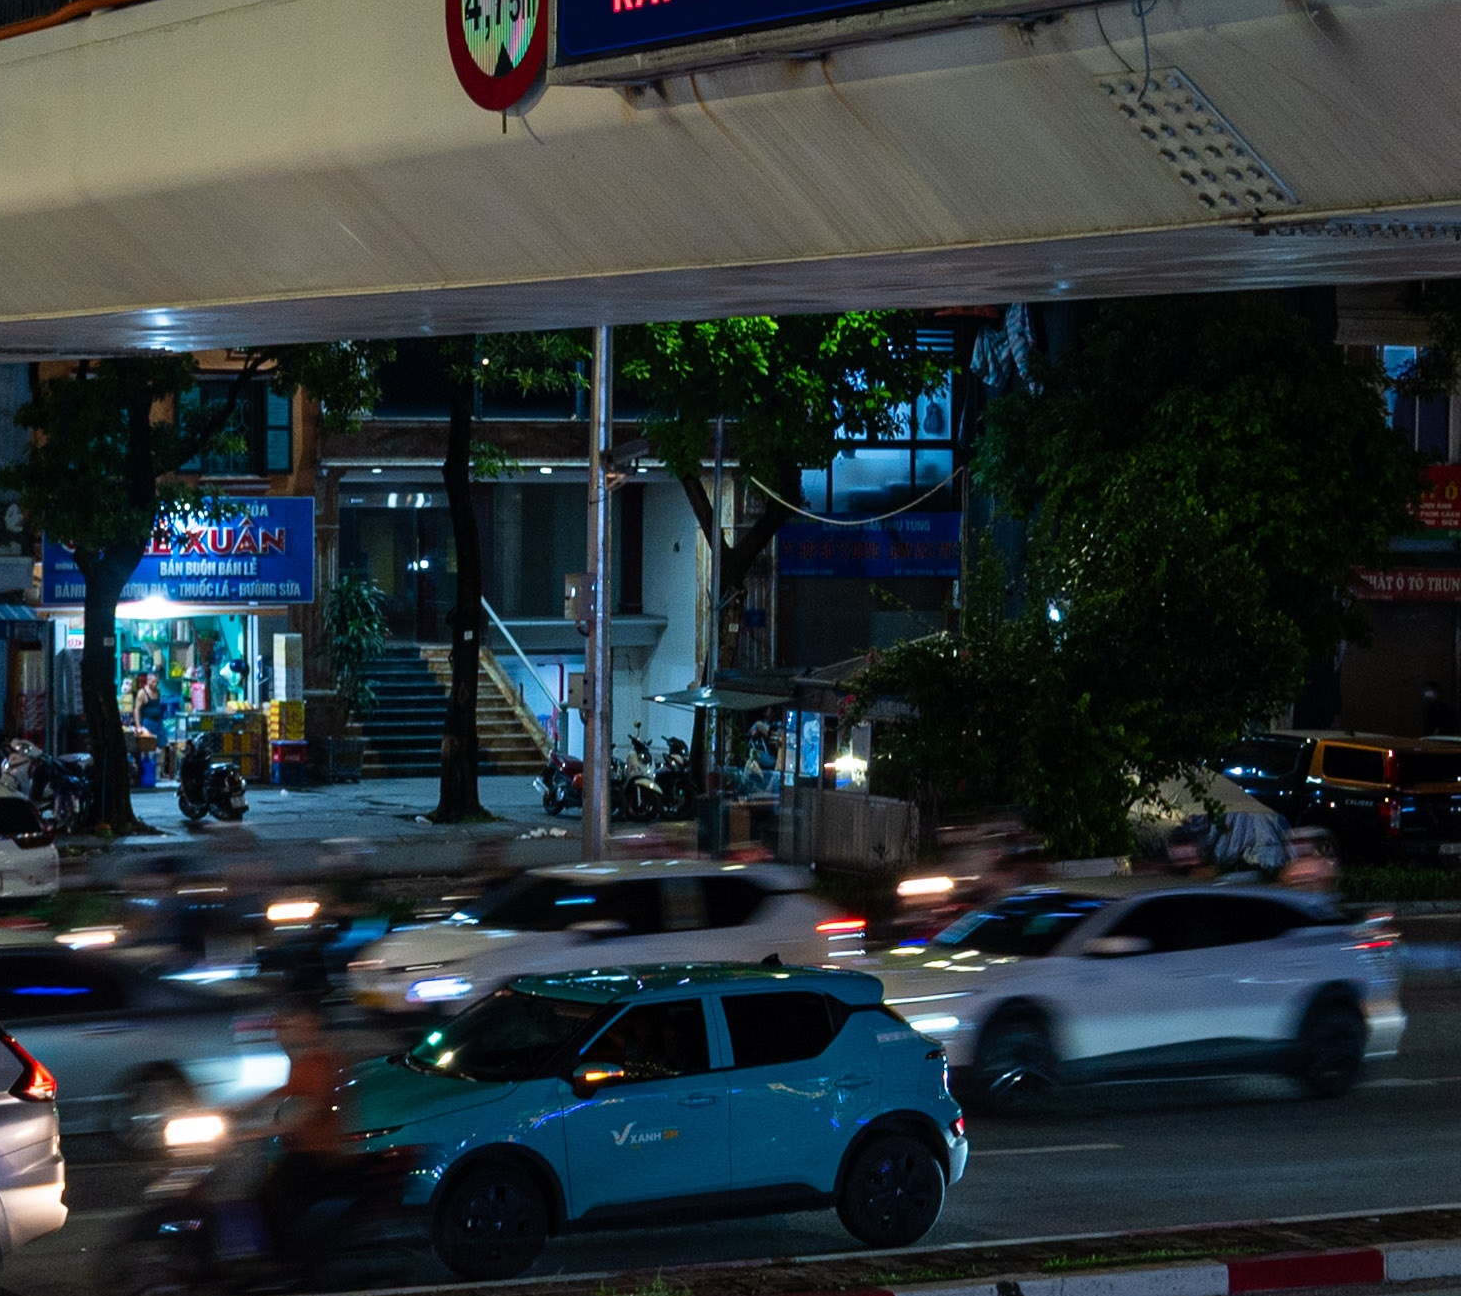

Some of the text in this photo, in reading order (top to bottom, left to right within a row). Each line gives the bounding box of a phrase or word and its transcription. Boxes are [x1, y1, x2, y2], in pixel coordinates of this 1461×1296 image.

[159, 560, 183, 577] BÁN
[178, 578, 213, 598] THUỐC
[630, 1130, 662, 1145] XANH
